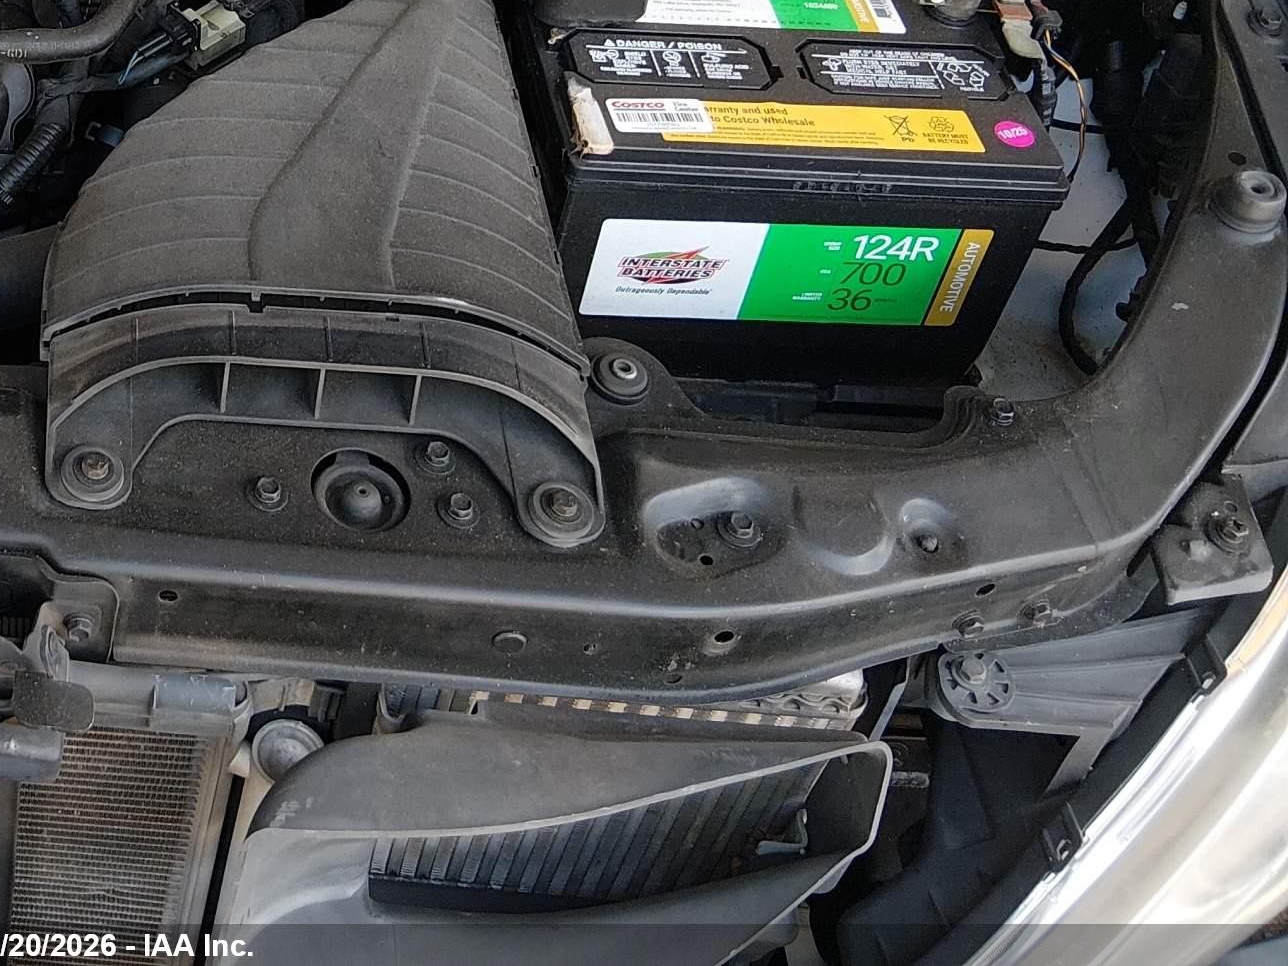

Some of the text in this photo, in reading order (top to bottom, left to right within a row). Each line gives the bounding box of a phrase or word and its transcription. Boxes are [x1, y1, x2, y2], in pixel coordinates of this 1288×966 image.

[616, 39, 666, 49] DANGER
[677, 42, 722, 51] POISON
[742, 106, 761, 115] and
[764, 107, 788, 116] used
[724, 115, 759, 124] Costco
[761, 116, 815, 127] Wholesale
[998, 126, 1027, 139] 10/25
[853, 234, 940, 262] 124R
[619, 257, 725, 270] INTERSTATE
[619, 267, 713, 278] BATTERIES
[840, 261, 906, 286] 700
[939, 241, 981, 313] AUTOMOTIVE
[615, 285, 710, 296] Outrageously Dependable
[827, 287, 872, 312] 36
